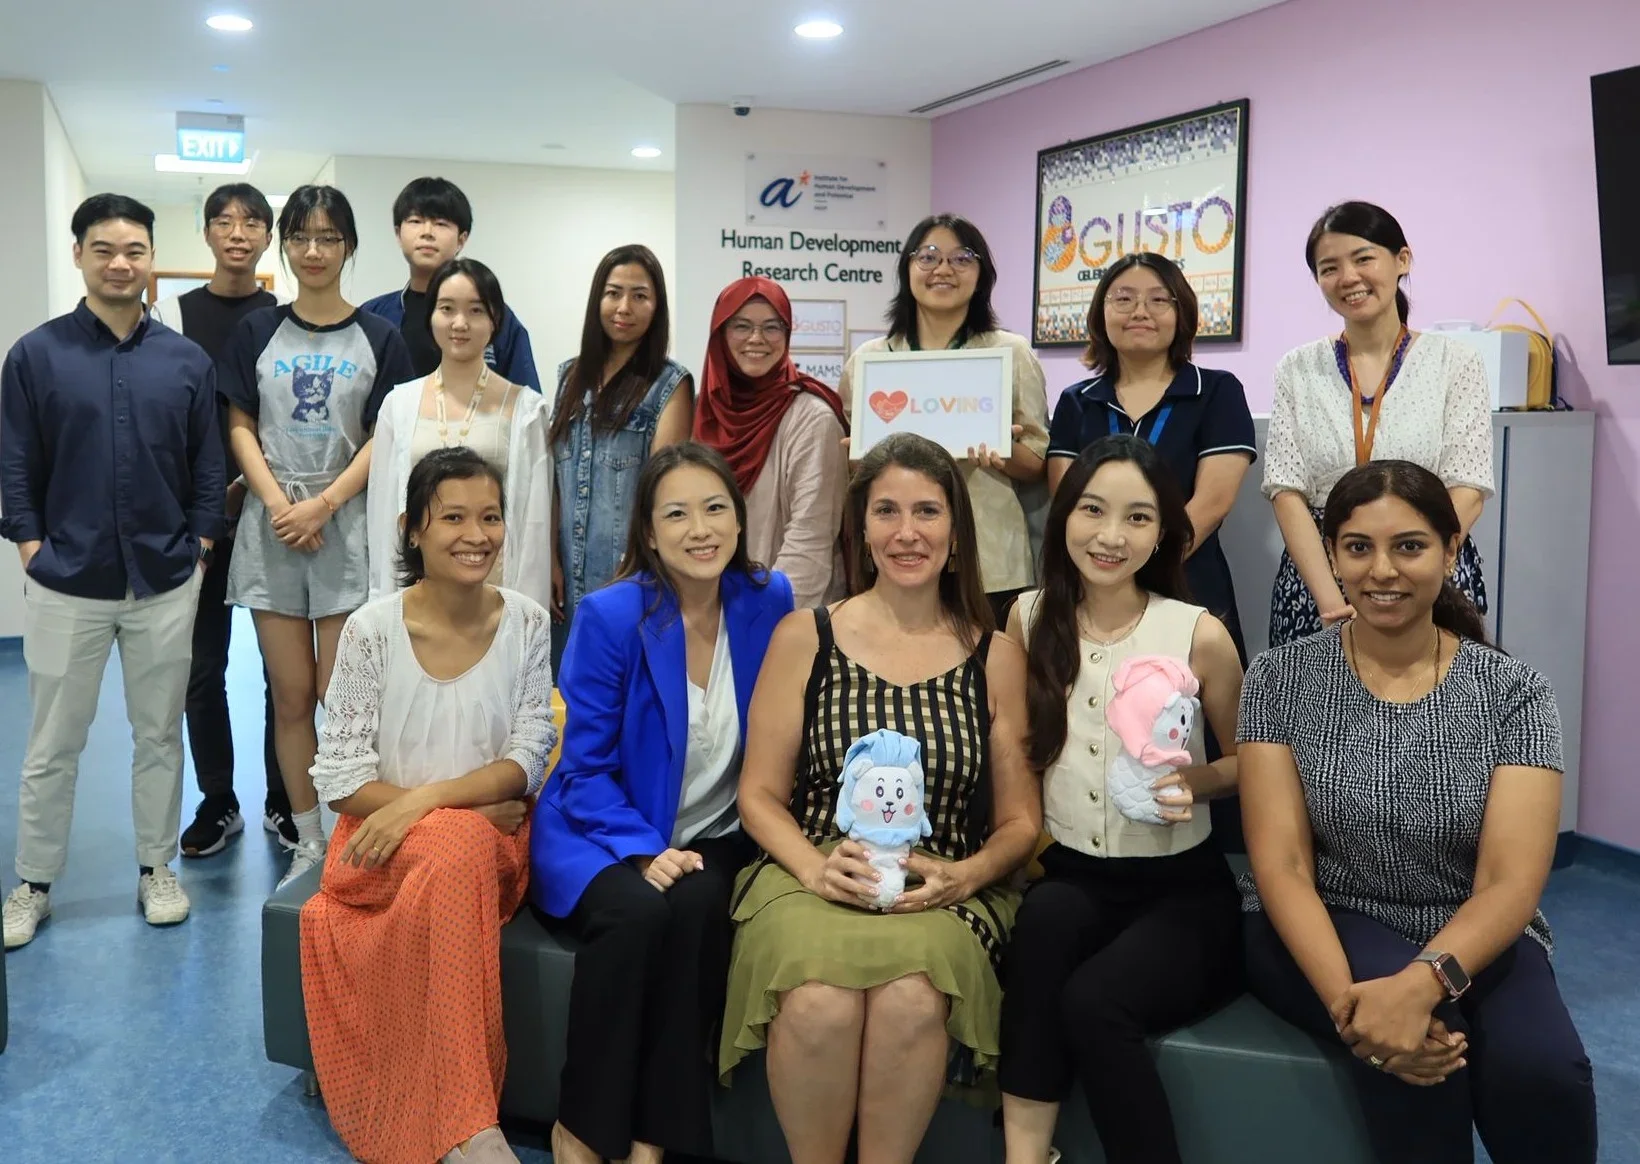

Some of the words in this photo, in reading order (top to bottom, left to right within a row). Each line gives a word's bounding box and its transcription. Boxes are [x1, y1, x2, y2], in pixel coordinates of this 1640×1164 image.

[183, 137, 227, 158] EXIT
[721, 229, 784, 250] Human
[789, 231, 902, 257] Development
[1079, 196, 1234, 268] GUSTO
[742, 261, 818, 282] Research
[824, 263, 883, 283] Centre
[273, 354, 357, 379] AGILE
[805, 364, 842, 378] MAMS
[910, 396, 994, 415] LOVING
